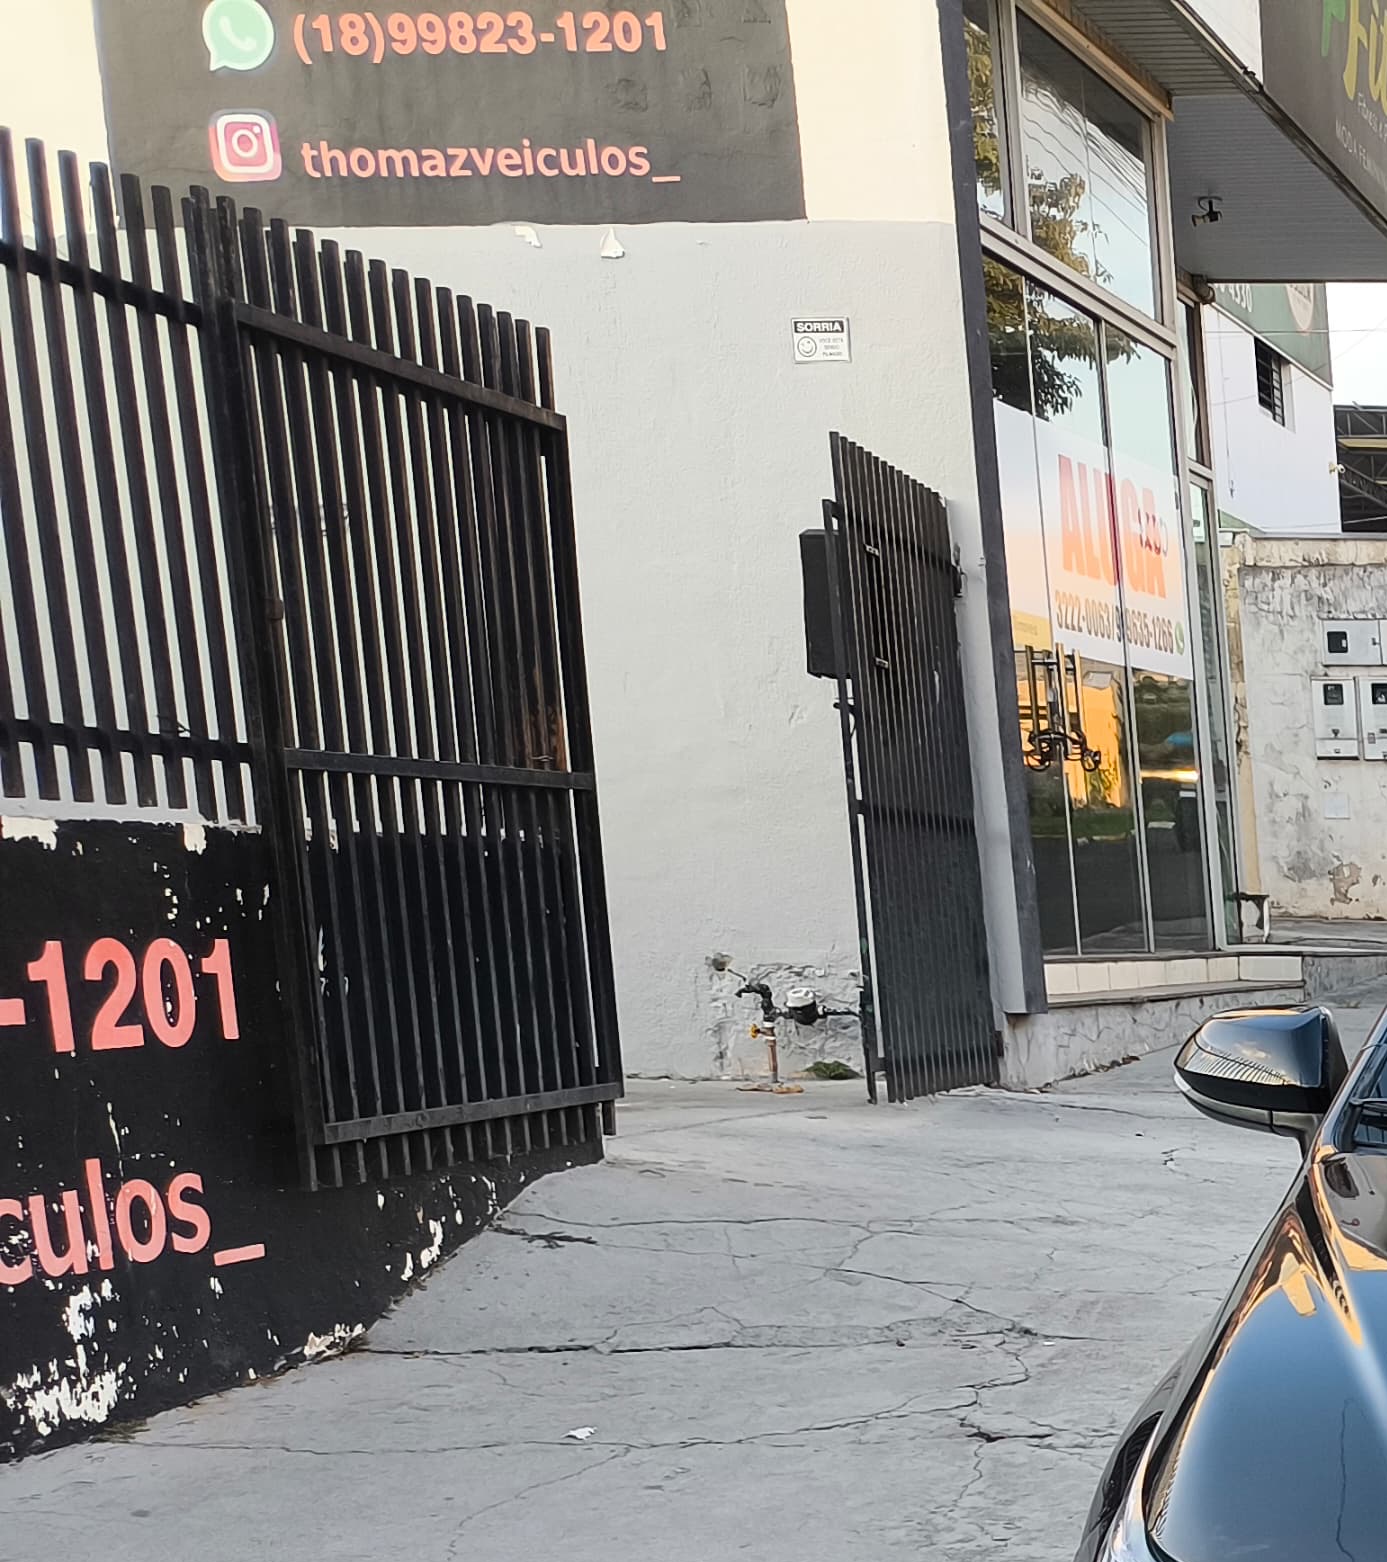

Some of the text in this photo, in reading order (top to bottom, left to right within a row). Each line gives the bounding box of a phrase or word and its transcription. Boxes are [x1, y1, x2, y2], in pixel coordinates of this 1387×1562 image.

[292, 11, 667, 65] (18)99823-1201
[301, 139, 681, 182] thomazveiculos_
[796, 322, 842, 332] SORRIA
[1057, 454, 1167, 599] ALUGA
[0, 937, 240, 1053] -1201
[0, 1158, 266, 1285] culos_
